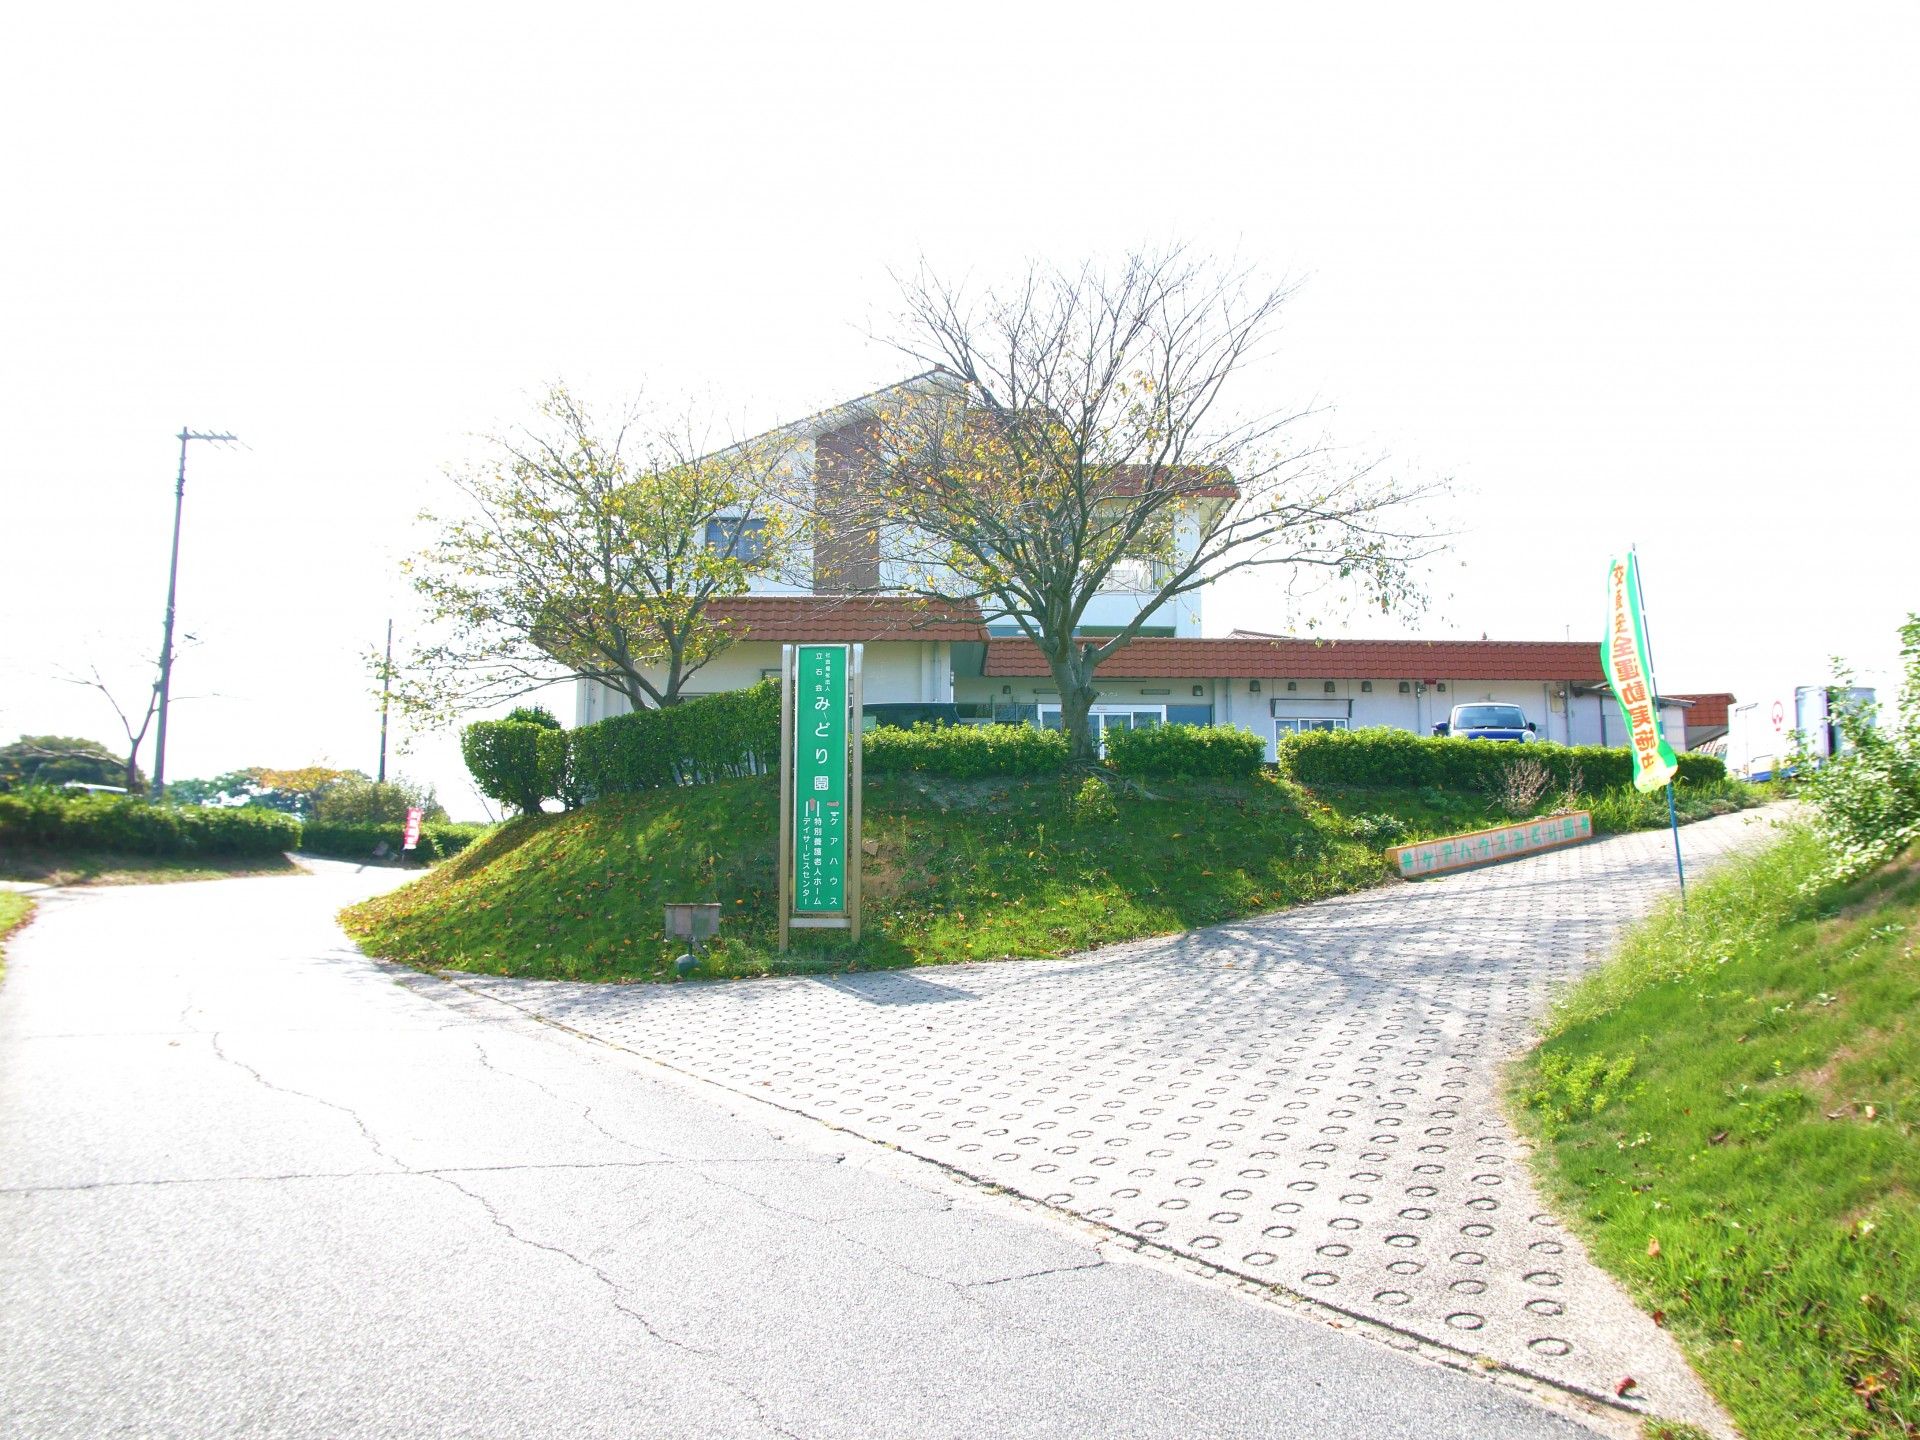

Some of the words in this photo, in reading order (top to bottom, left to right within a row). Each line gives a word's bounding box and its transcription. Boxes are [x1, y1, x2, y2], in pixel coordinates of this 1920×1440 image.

[815, 652, 823, 692] 立石会
[814, 696, 830, 791] みどり園
[803, 818, 811, 905] デイサービスセンター
[813, 818, 822, 905] 特別養護老人ホーム
[830, 818, 839, 905] ケアハウス
